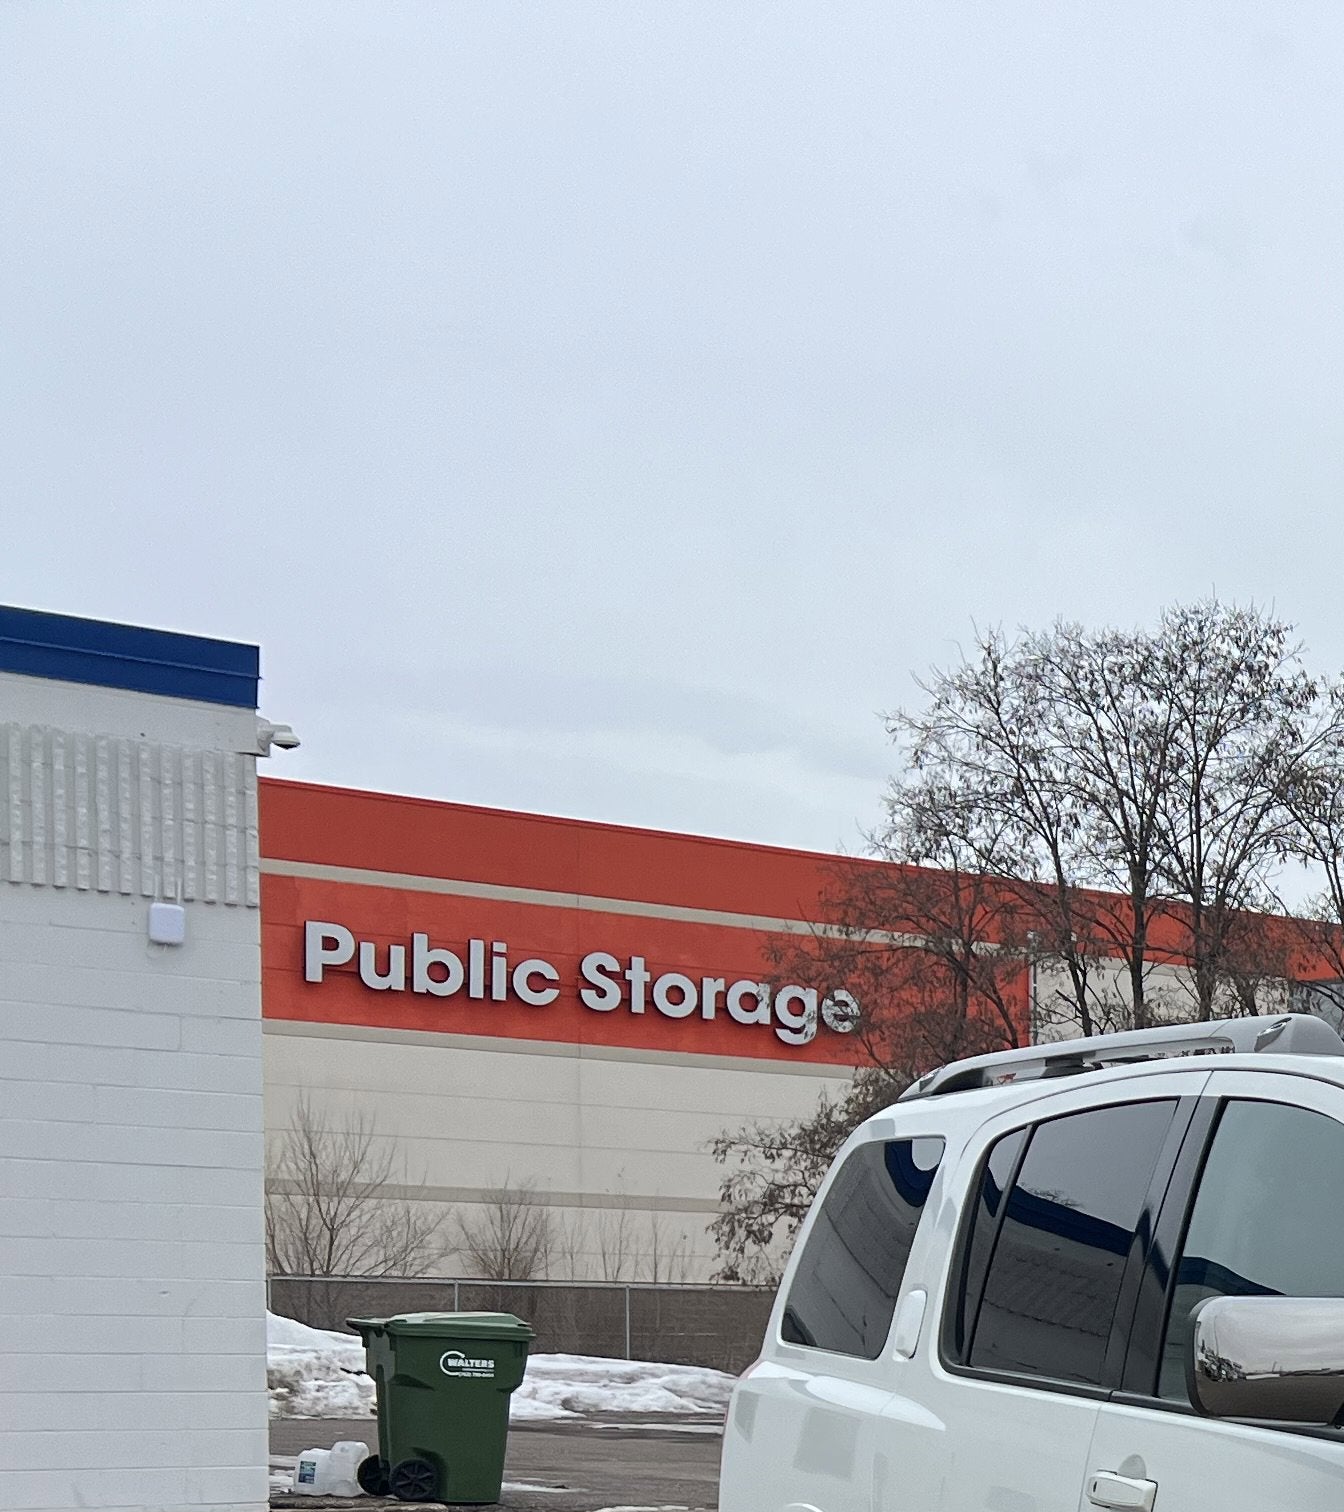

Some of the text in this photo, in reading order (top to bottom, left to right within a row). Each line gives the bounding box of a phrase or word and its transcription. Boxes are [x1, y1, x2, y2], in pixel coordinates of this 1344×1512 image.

[303, 919, 860, 1046] Public Storage
[447, 1358, 495, 1368] WALTERS
